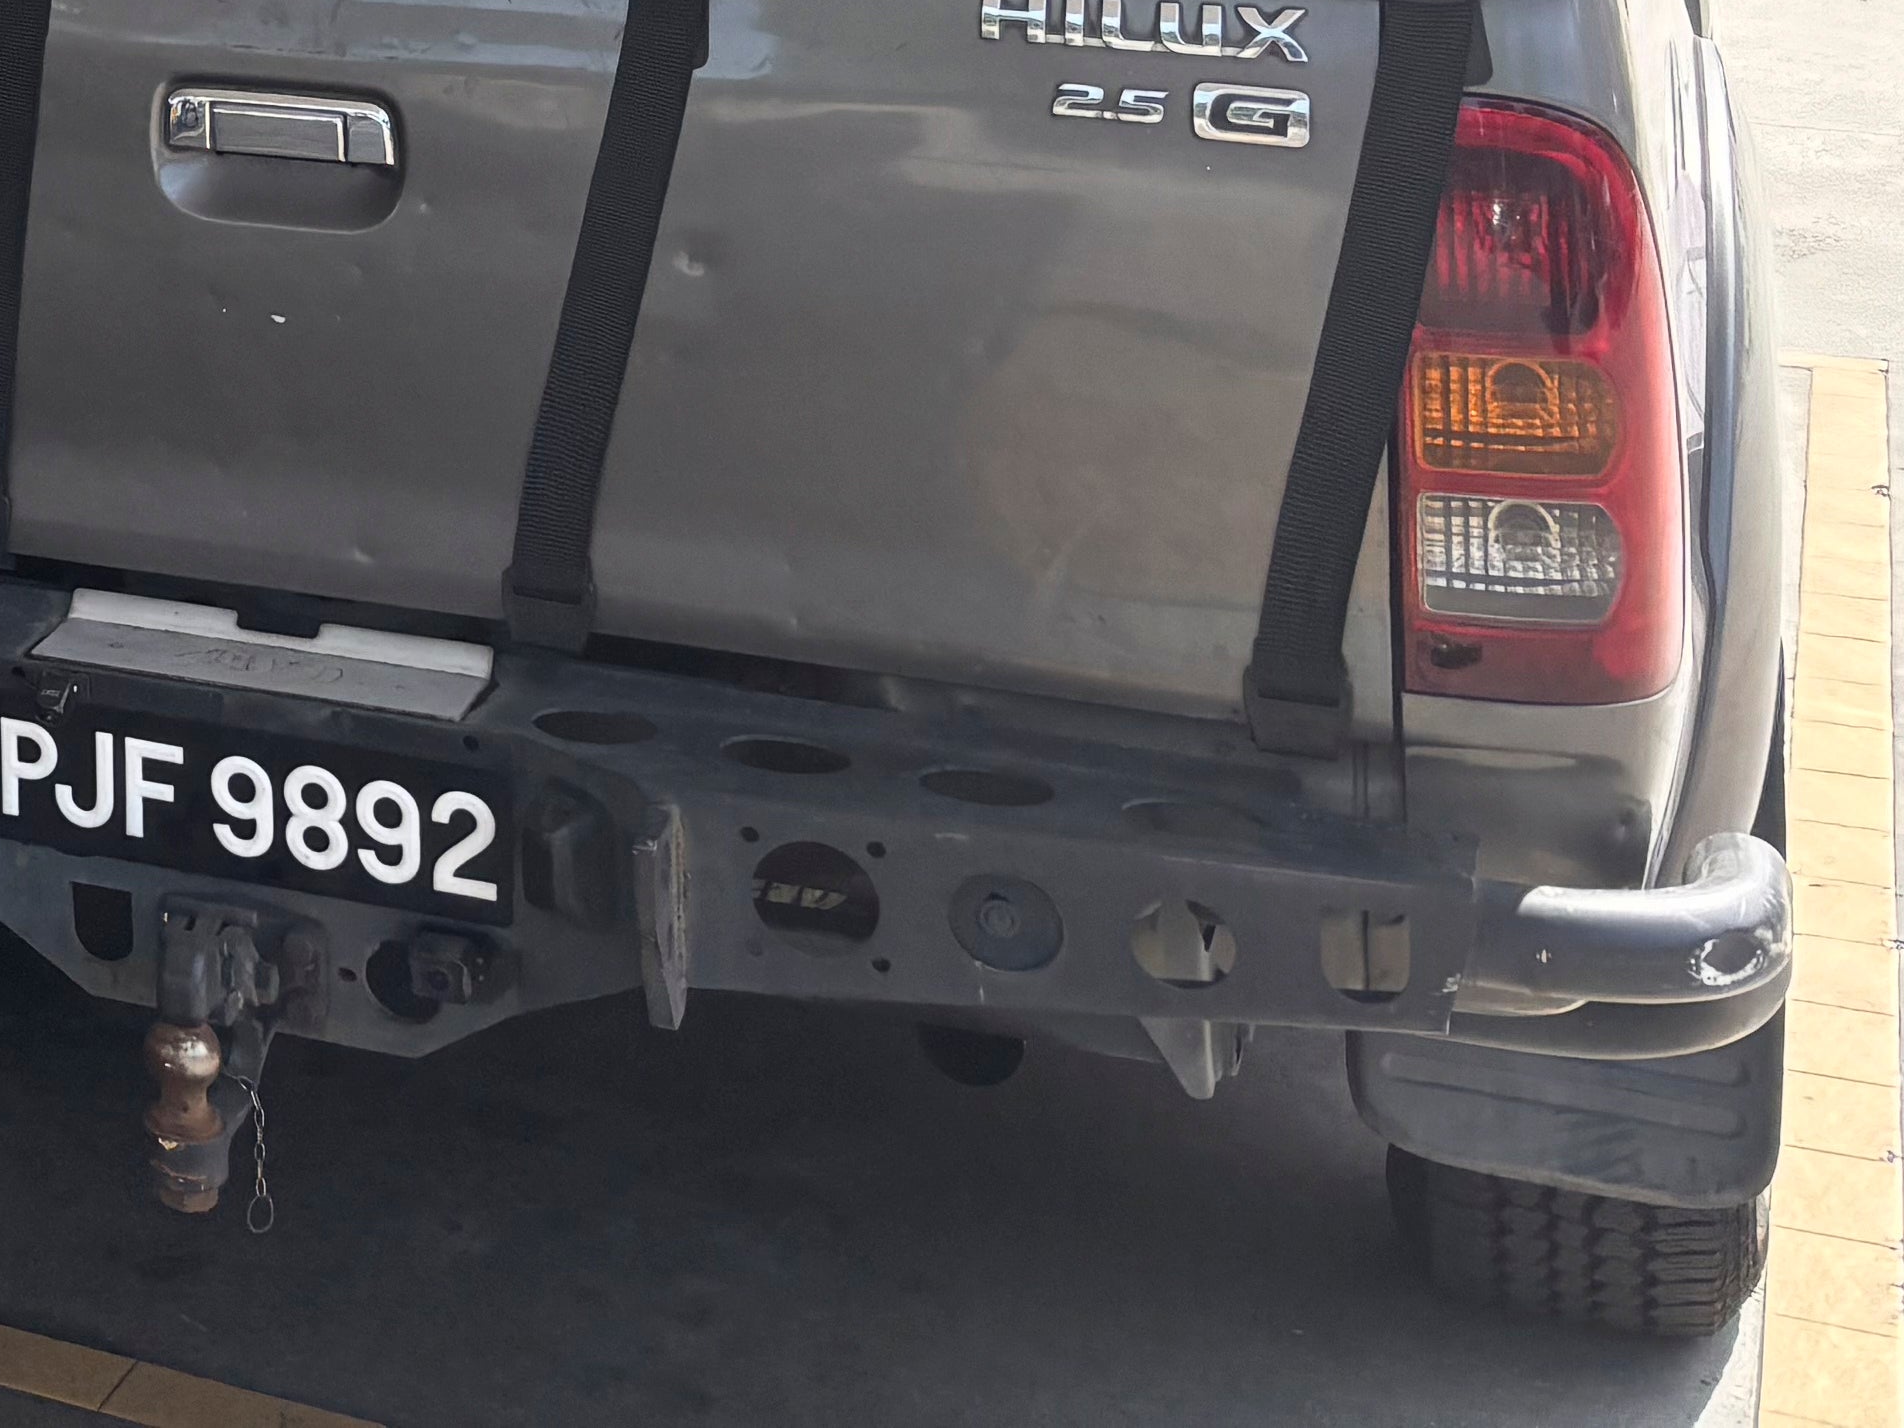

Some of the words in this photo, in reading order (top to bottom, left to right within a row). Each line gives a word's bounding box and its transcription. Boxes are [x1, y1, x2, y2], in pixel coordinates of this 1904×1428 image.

[1201, 85, 1302, 143] G
[0, 716, 184, 838] PJF
[210, 754, 498, 902] 9892
